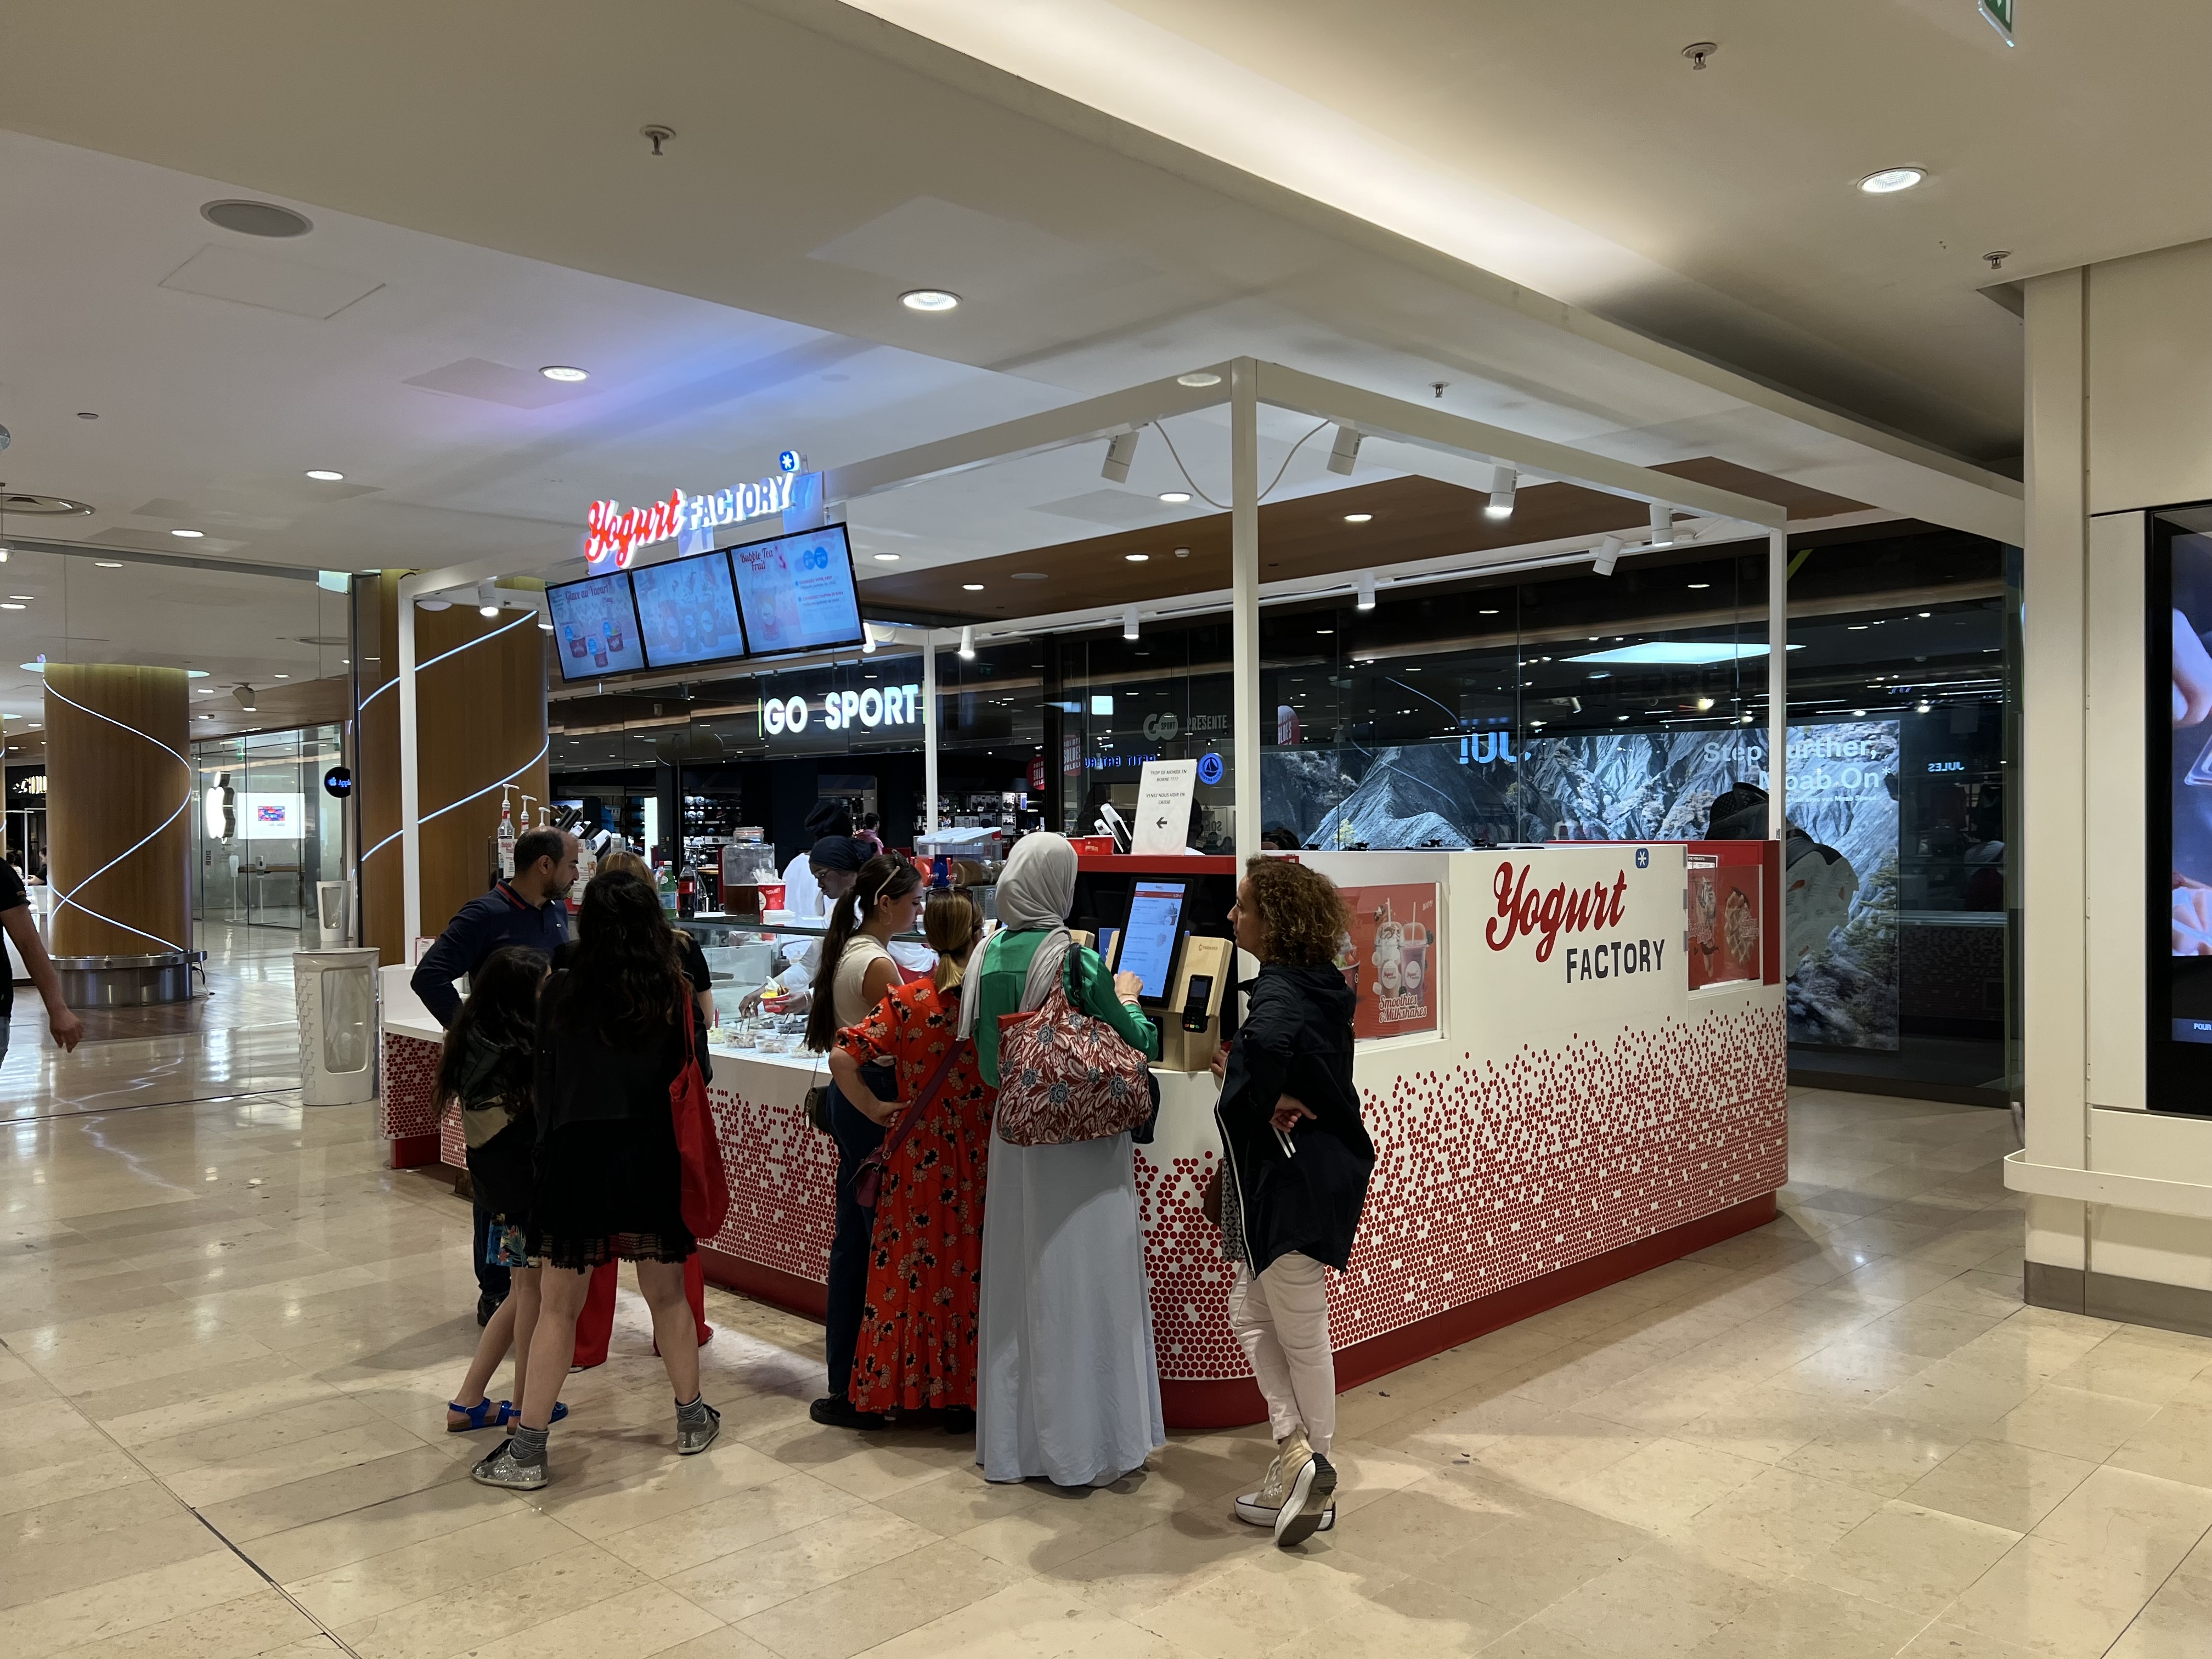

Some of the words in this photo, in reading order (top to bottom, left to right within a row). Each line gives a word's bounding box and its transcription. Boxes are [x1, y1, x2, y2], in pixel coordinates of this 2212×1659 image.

[585, 488, 686, 568] Yogurt
[688, 473, 795, 531] FACTORY
[740, 551, 761, 563] Bubble
[565, 589, 579, 603] Glace
[764, 696, 808, 735] GO
[825, 684, 918, 730] SPORT
[1161, 721, 1176, 730] SPORT
[1703, 742, 1762, 766] Step
[1486, 861, 1628, 963] Yogurt
[1567, 939, 1666, 984] FACTORY
[1379, 992, 1418, 1011] Smoothies
[2194, 1023, 2211, 1031] POUR
